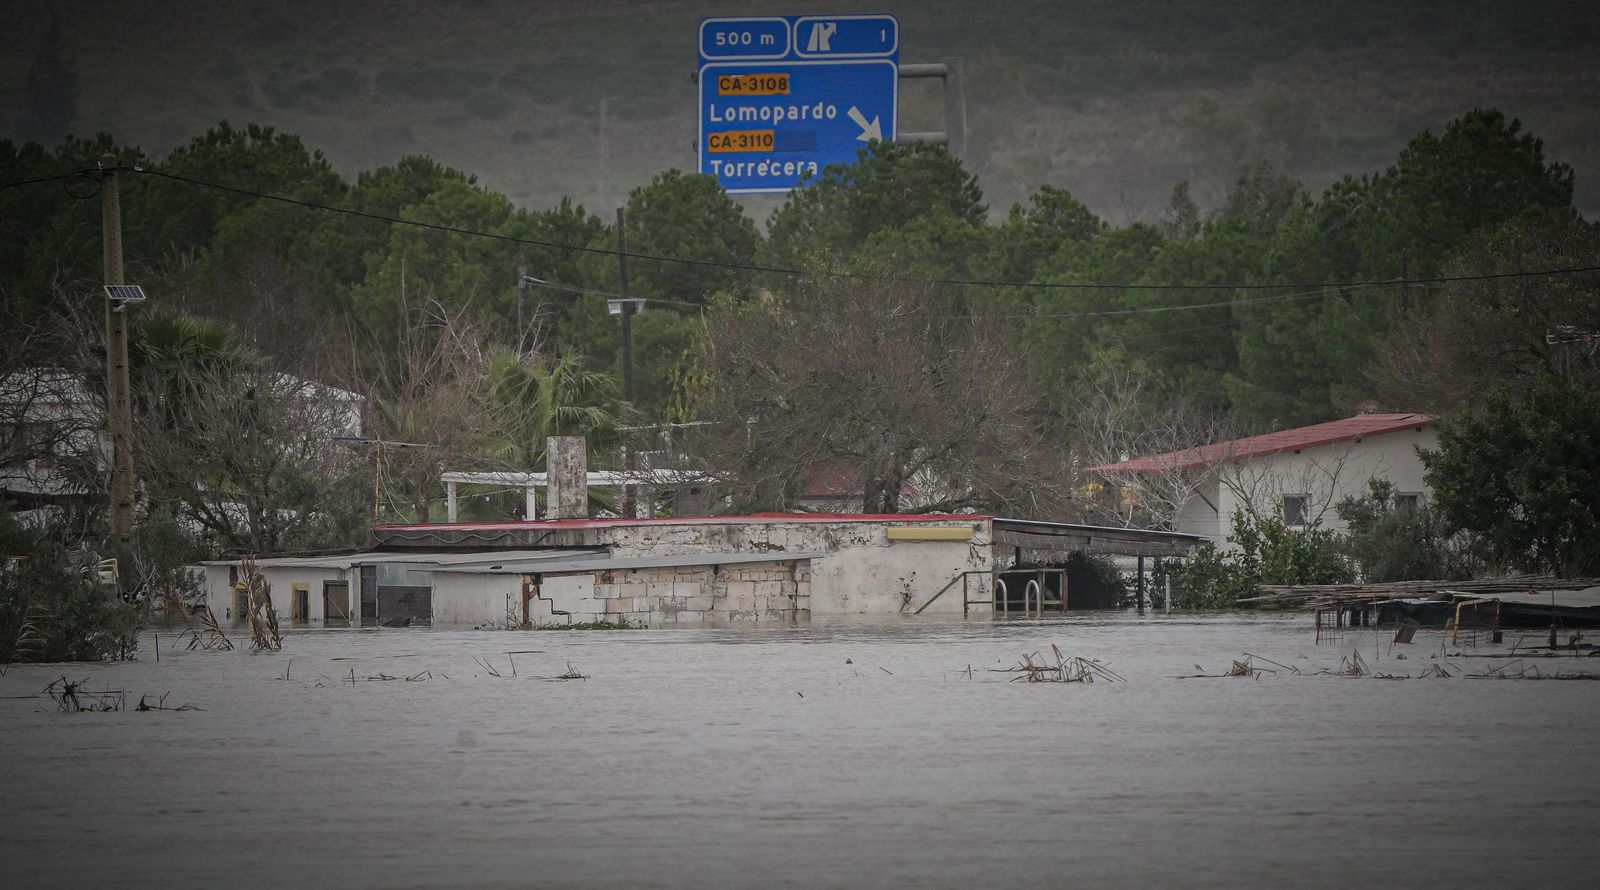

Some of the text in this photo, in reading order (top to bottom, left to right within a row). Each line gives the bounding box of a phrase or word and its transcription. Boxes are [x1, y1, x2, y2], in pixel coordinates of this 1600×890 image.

[716, 32, 774, 45] 500 m
[880, 29, 886, 42] 1
[719, 78, 788, 91] CA-3108
[710, 102, 837, 125] Lomopardo
[709, 134, 773, 148] CA-3110
